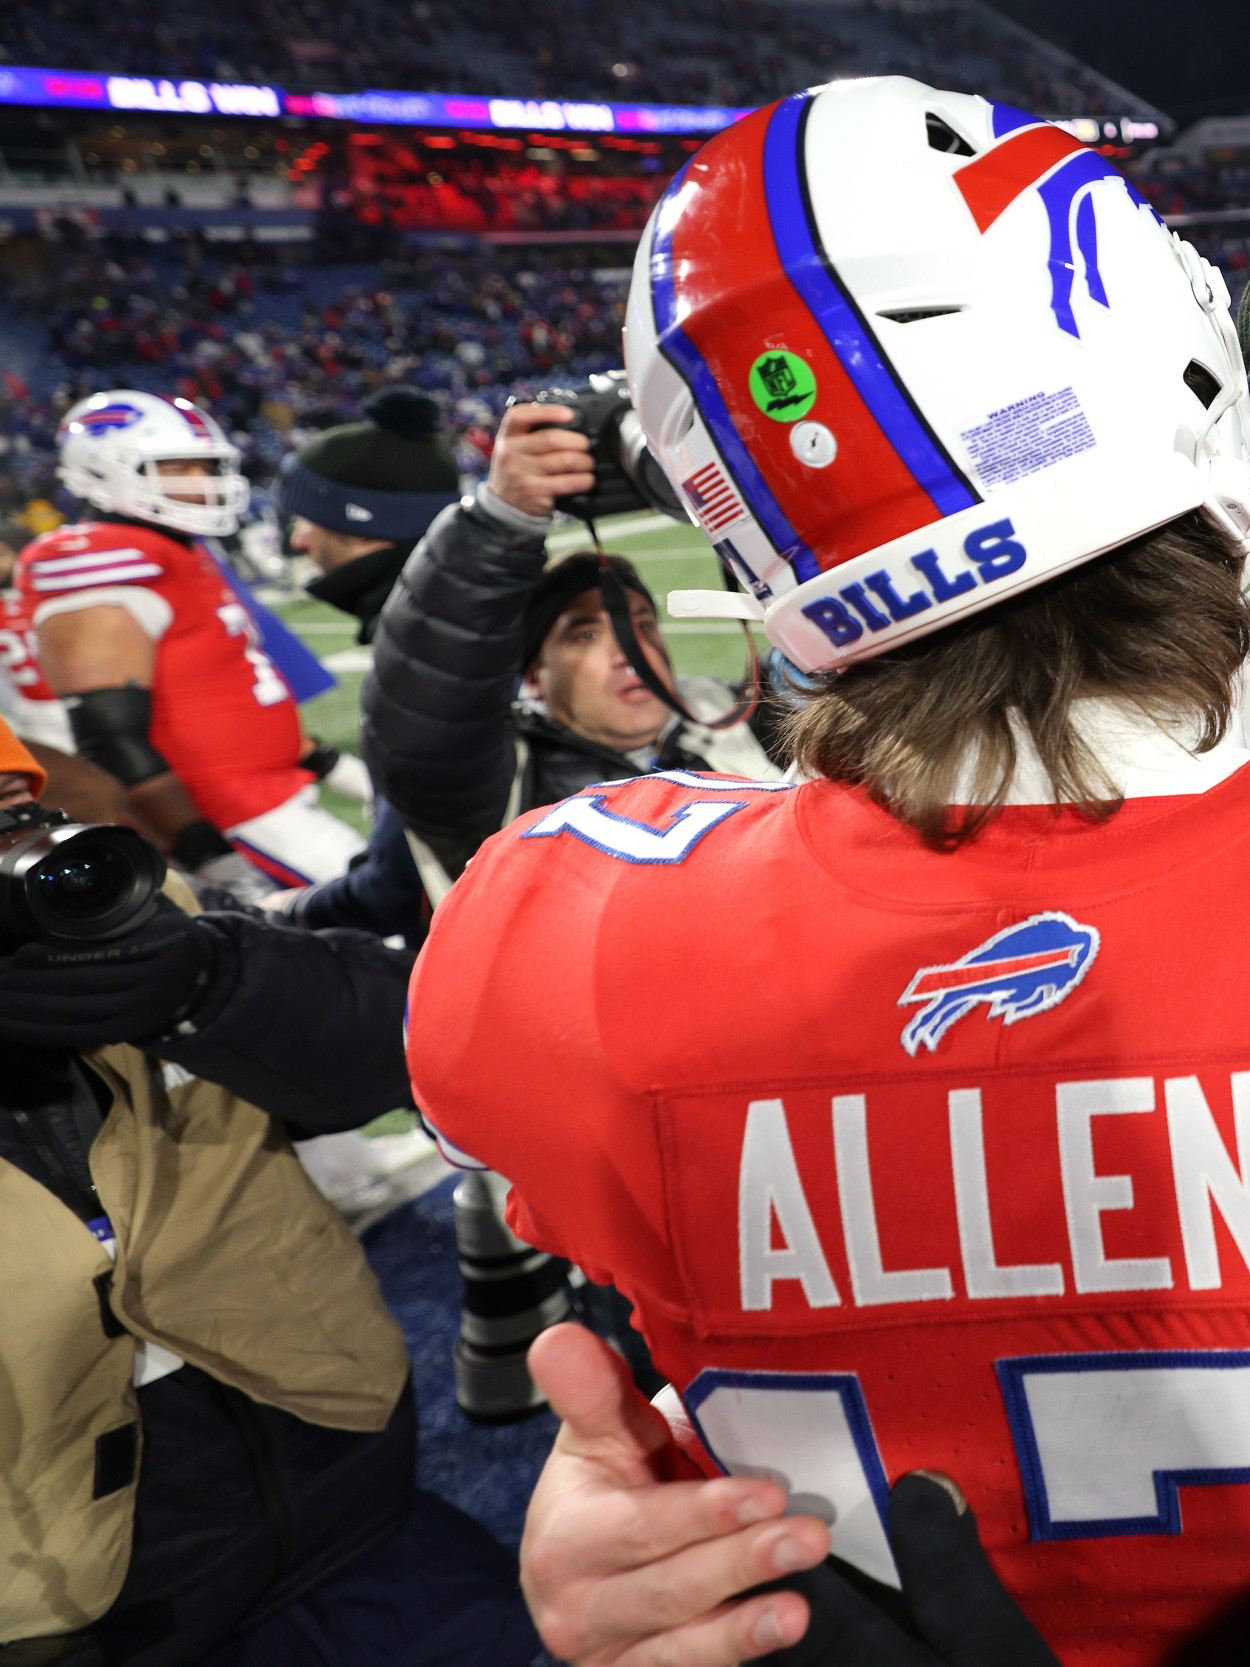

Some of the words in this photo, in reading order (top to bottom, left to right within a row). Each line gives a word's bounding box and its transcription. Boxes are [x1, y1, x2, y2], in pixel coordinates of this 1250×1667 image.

[106, 76, 212, 113] BILLS
[209, 82, 280, 117] WIN
[488, 99, 566, 130] BILLS
[562, 102, 615, 131] WIN
[987, 390, 1046, 420] WARNING
[800, 516, 1028, 648] BILLS
[47, 948, 122, 964] UNDER
